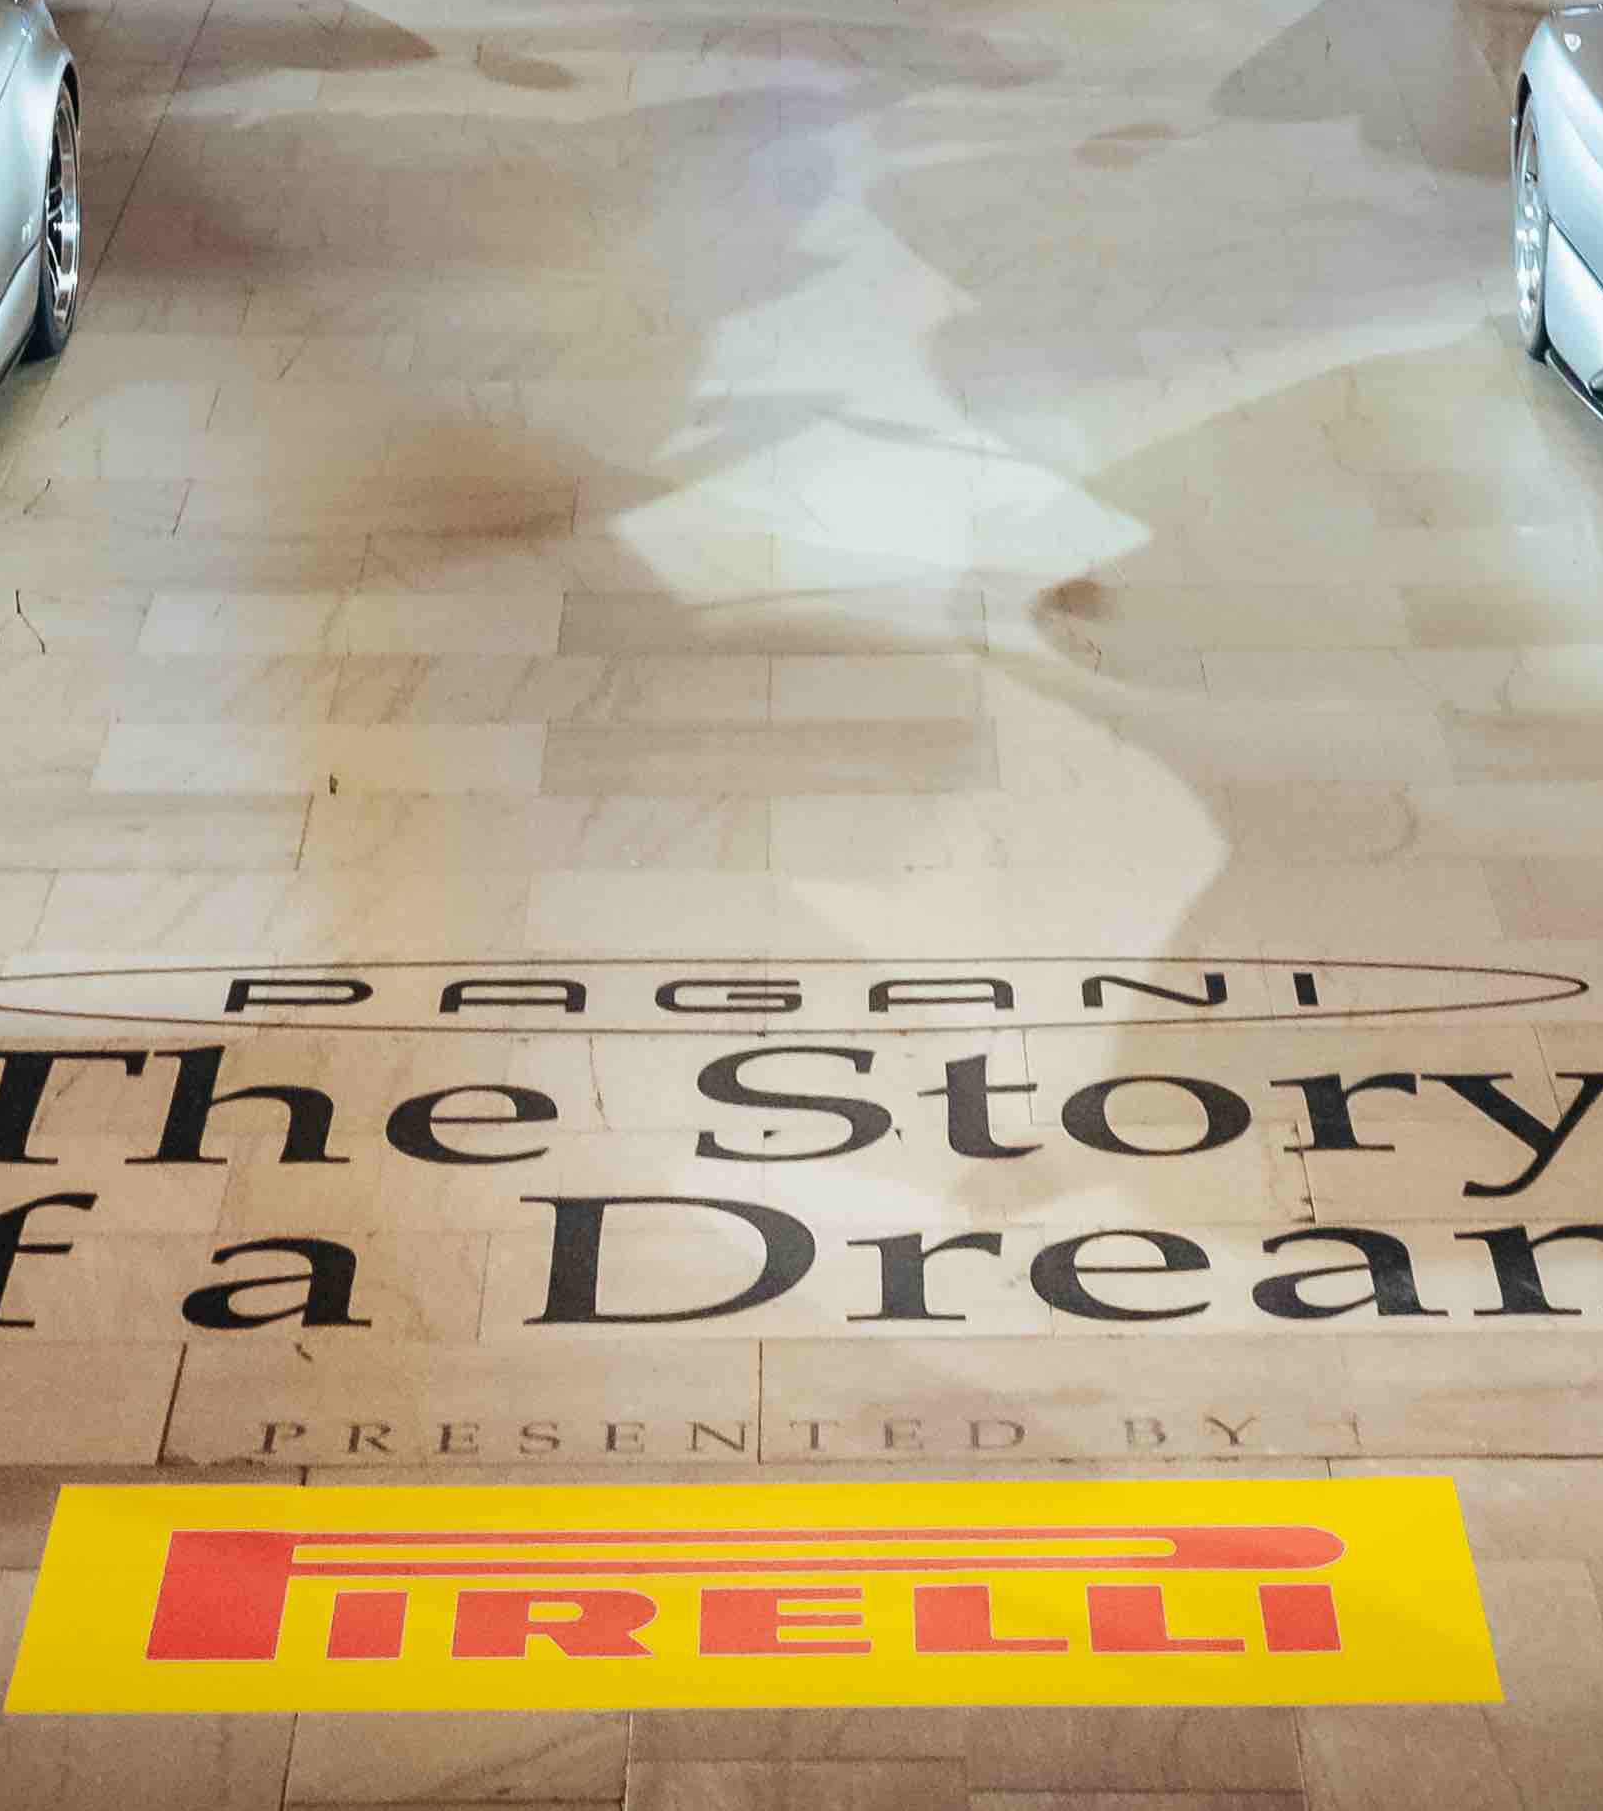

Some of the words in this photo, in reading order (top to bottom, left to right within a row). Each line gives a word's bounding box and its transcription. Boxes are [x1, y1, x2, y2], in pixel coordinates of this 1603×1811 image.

[224, 973, 1319, 1014] PAGANI
[181, 1236, 372, 1331] a
[255, 1419, 1031, 1457] PRESENTED
[1122, 1416, 1261, 1452] BY
[144, 1524, 1347, 1661] PIRELLI
